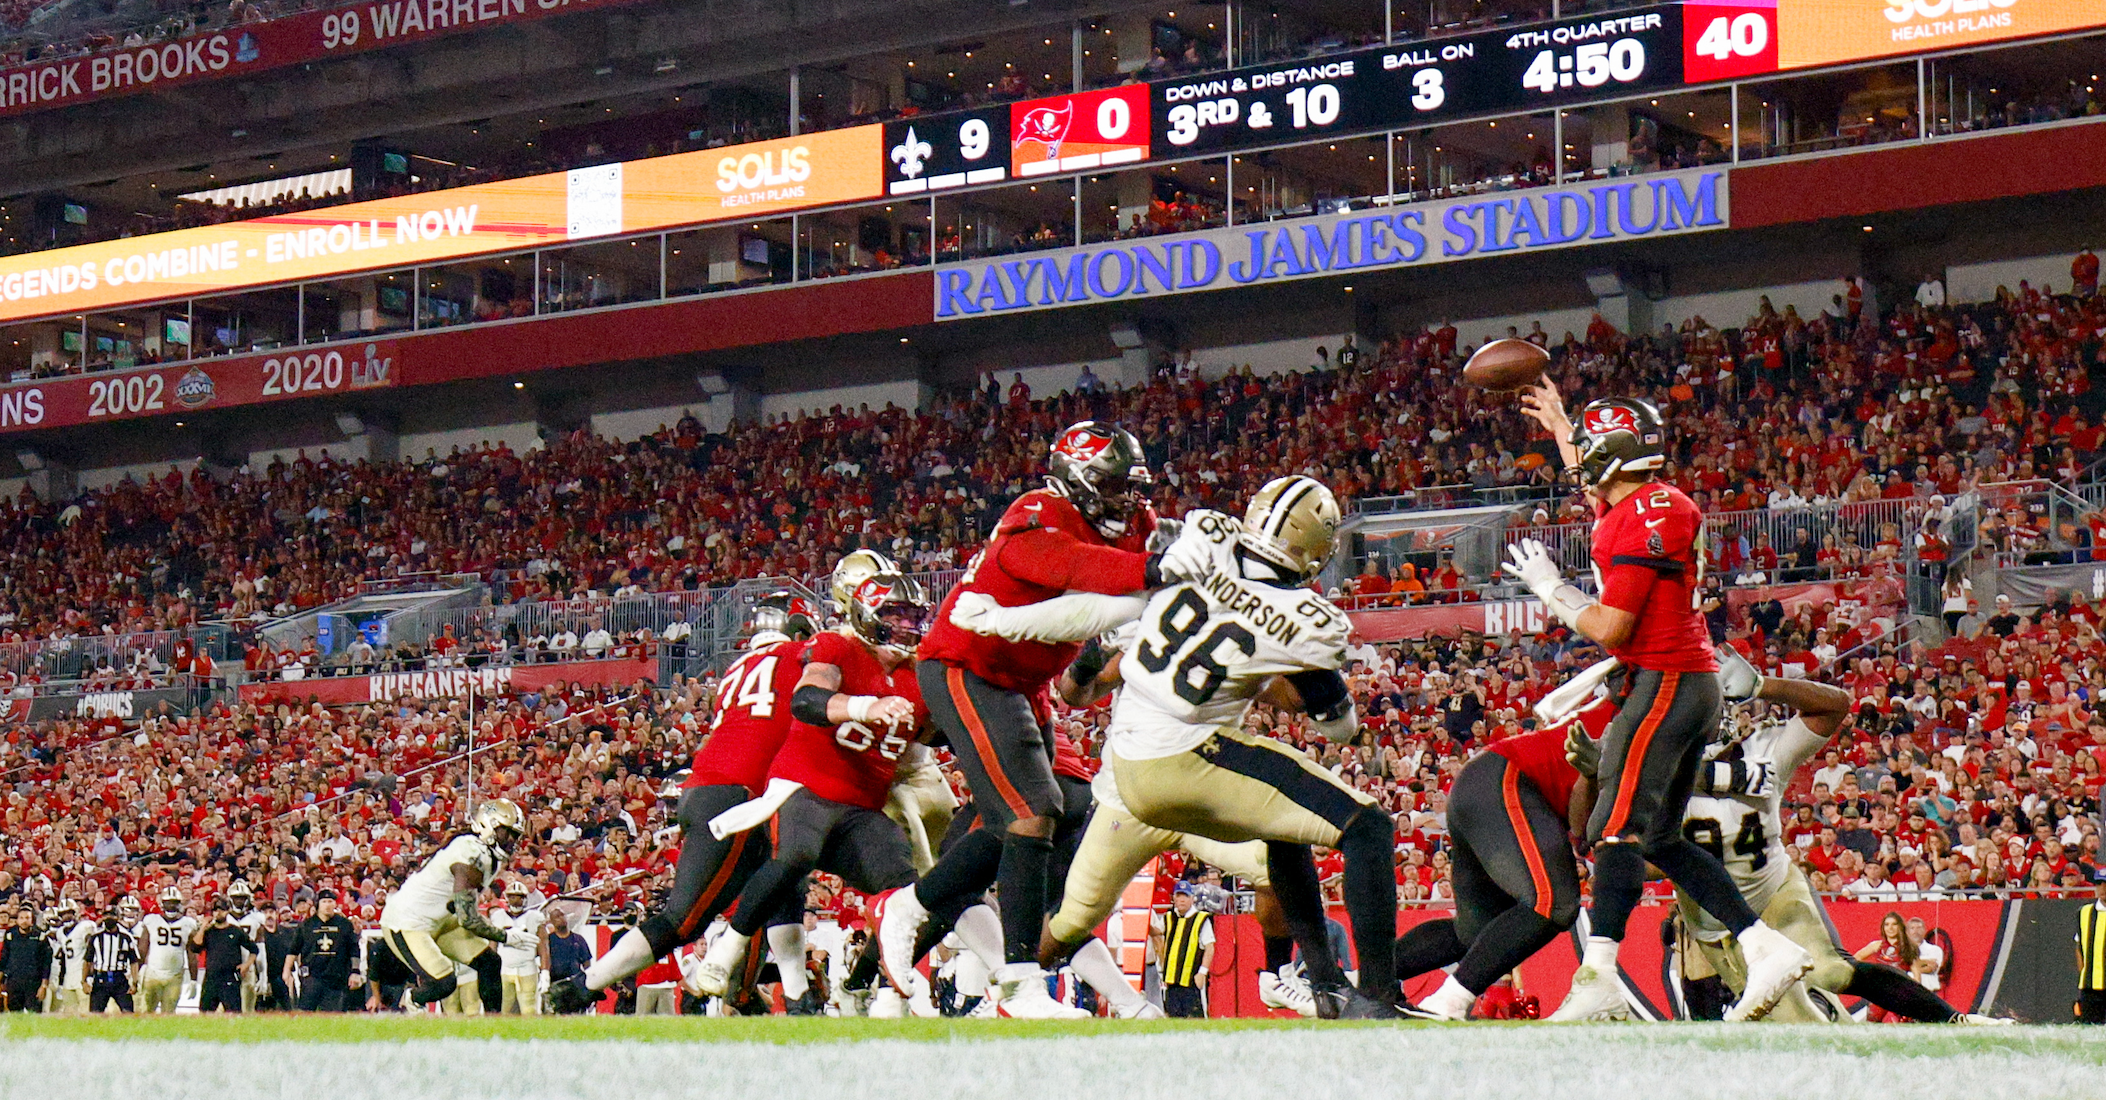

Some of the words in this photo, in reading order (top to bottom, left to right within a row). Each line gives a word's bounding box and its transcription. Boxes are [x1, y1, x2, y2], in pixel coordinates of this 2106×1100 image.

[322, 11, 361, 49] 99
[1505, 30, 1549, 49] 4TH
[1552, 13, 1662, 42] QUARTER
[1696, 12, 1768, 60] 40
[1891, 20, 1954, 41] HEALTH
[1957, 12, 2012, 32] PLANS
[91, 35, 230, 92] BROOKS
[1383, 49, 1438, 70] BALL
[1441, 43, 1474, 61] ON
[1522, 38, 1645, 93] 4:50
[1166, 80, 1228, 102] DOWN
[1231, 77, 1248, 92] &
[1252, 61, 1355, 89] DISTANCE
[1411, 68, 1445, 111] 3
[1097, 97, 1130, 140] 0
[1167, 98, 1240, 145] 3RD
[1247, 101, 1273, 129] &
[1286, 83, 1341, 129] 10
[959, 118, 990, 160] 9
[716, 146, 811, 192] SOLIS
[721, 191, 765, 207] HEALTH
[767, 185, 805, 201] PLANS
[0, 261, 97, 301] GENDS
[104, 239, 239, 286] COMBINE
[266, 219, 388, 263] ENROLL
[396, 204, 478, 245] NOW
[936, 237, 1222, 317] RAYMOND
[1228, 210, 1427, 283] JAMES
[1441, 172, 1725, 257] STADIUM
[1342, 351, 1354, 364] 12
[88, 373, 164, 417] 2002
[262, 350, 343, 396] 2020
[1635, 489, 1672, 515] 12
[1485, 600, 1552, 635] BUC
[1138, 587, 1256, 706] 96
[713, 655, 779, 730] 74
[1683, 811, 1767, 872] 94
[157, 926, 182, 947] 95
